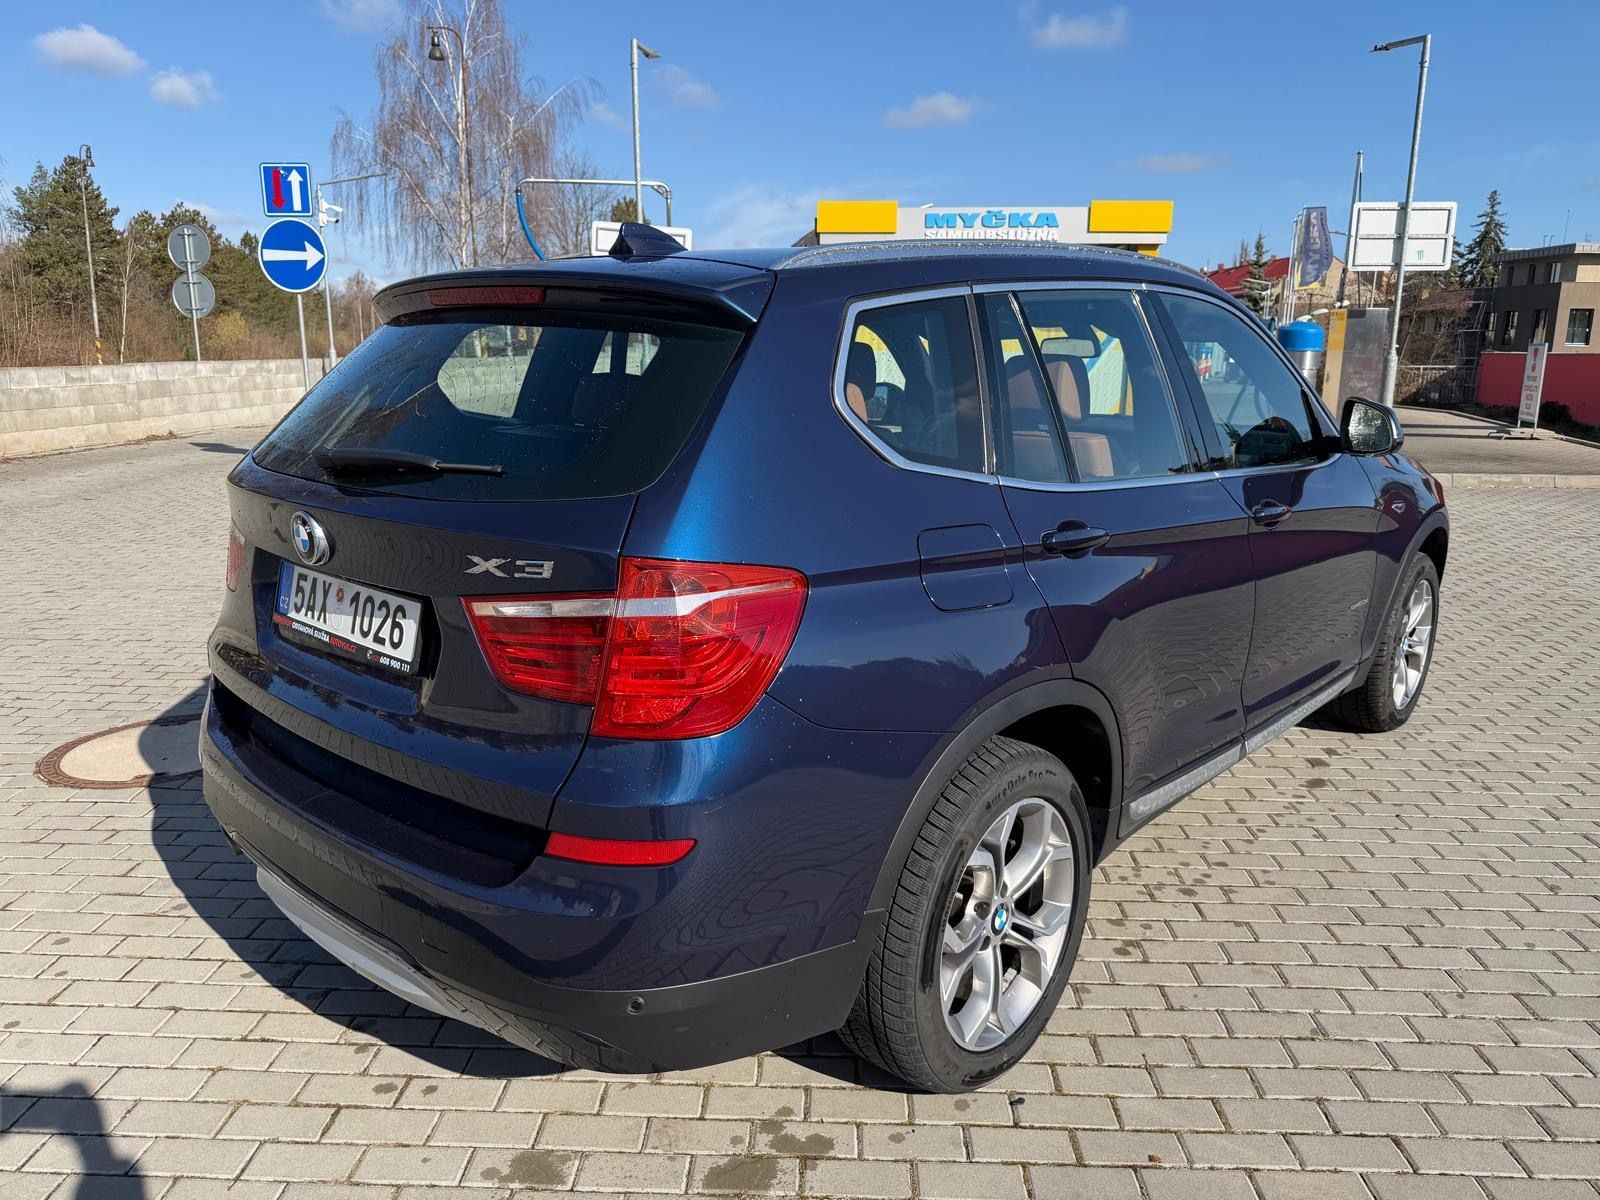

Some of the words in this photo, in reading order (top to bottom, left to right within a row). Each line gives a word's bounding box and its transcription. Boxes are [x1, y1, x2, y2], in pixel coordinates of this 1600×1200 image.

[924, 210, 1059, 228] MYČKA
[464, 555, 554, 578] X3
[280, 596, 289, 609] CZ
[293, 572, 332, 624] 5AX
[349, 590, 407, 650] 1026
[379, 655, 390, 666] 608
[390, 659, 401, 670] 900
